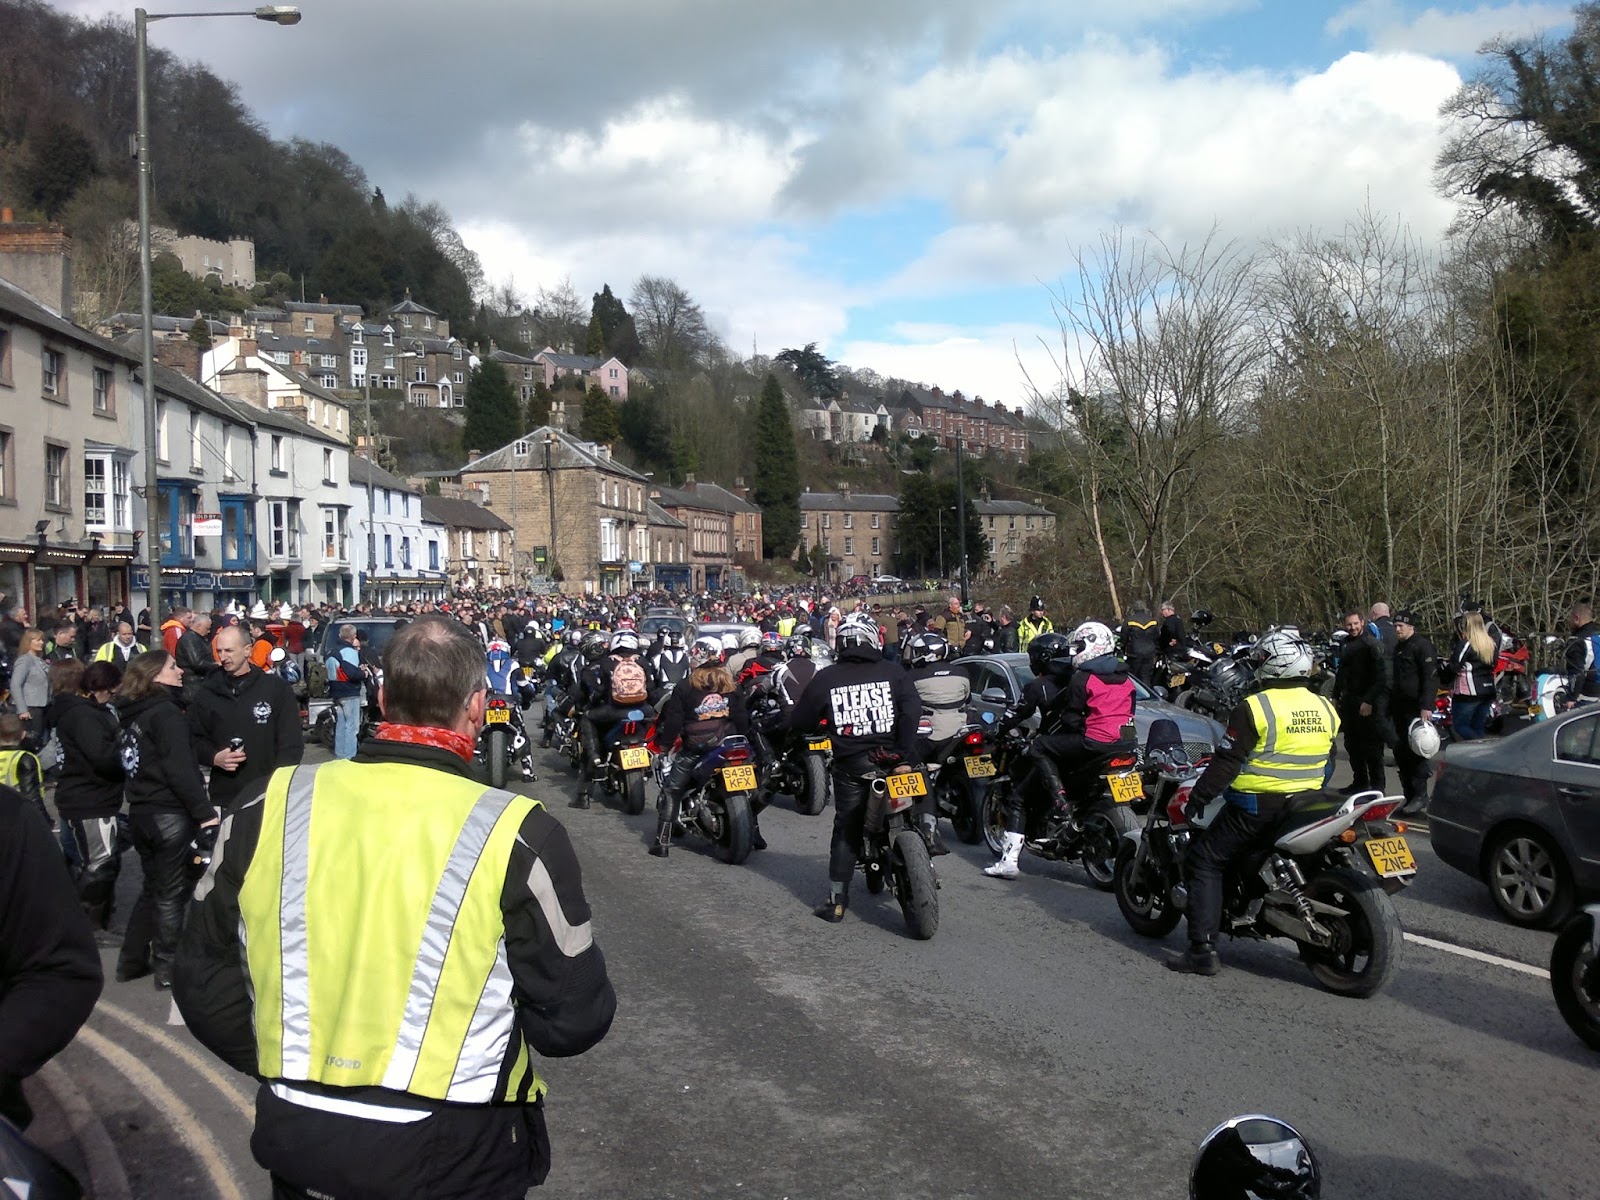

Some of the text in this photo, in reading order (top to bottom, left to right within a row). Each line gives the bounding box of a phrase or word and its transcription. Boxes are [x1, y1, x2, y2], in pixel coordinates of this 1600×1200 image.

[836, 686, 848, 694] YOU
[848, 684, 861, 692] CAN
[876, 681, 890, 689] THIS
[830, 687, 893, 712] PLEASE
[834, 704, 895, 726] BACK THE
[1291, 710, 1320, 718] NOTTZ
[1291, 717, 1322, 726] BIKERZ
[1286, 725, 1328, 734] MARSHAL
[723, 766, 752, 779] S438
[729, 777, 752, 788] KFX
[895, 784, 920, 796] GVK
[1369, 839, 1406, 857] EX04
[1380, 855, 1411, 872] ZNE
